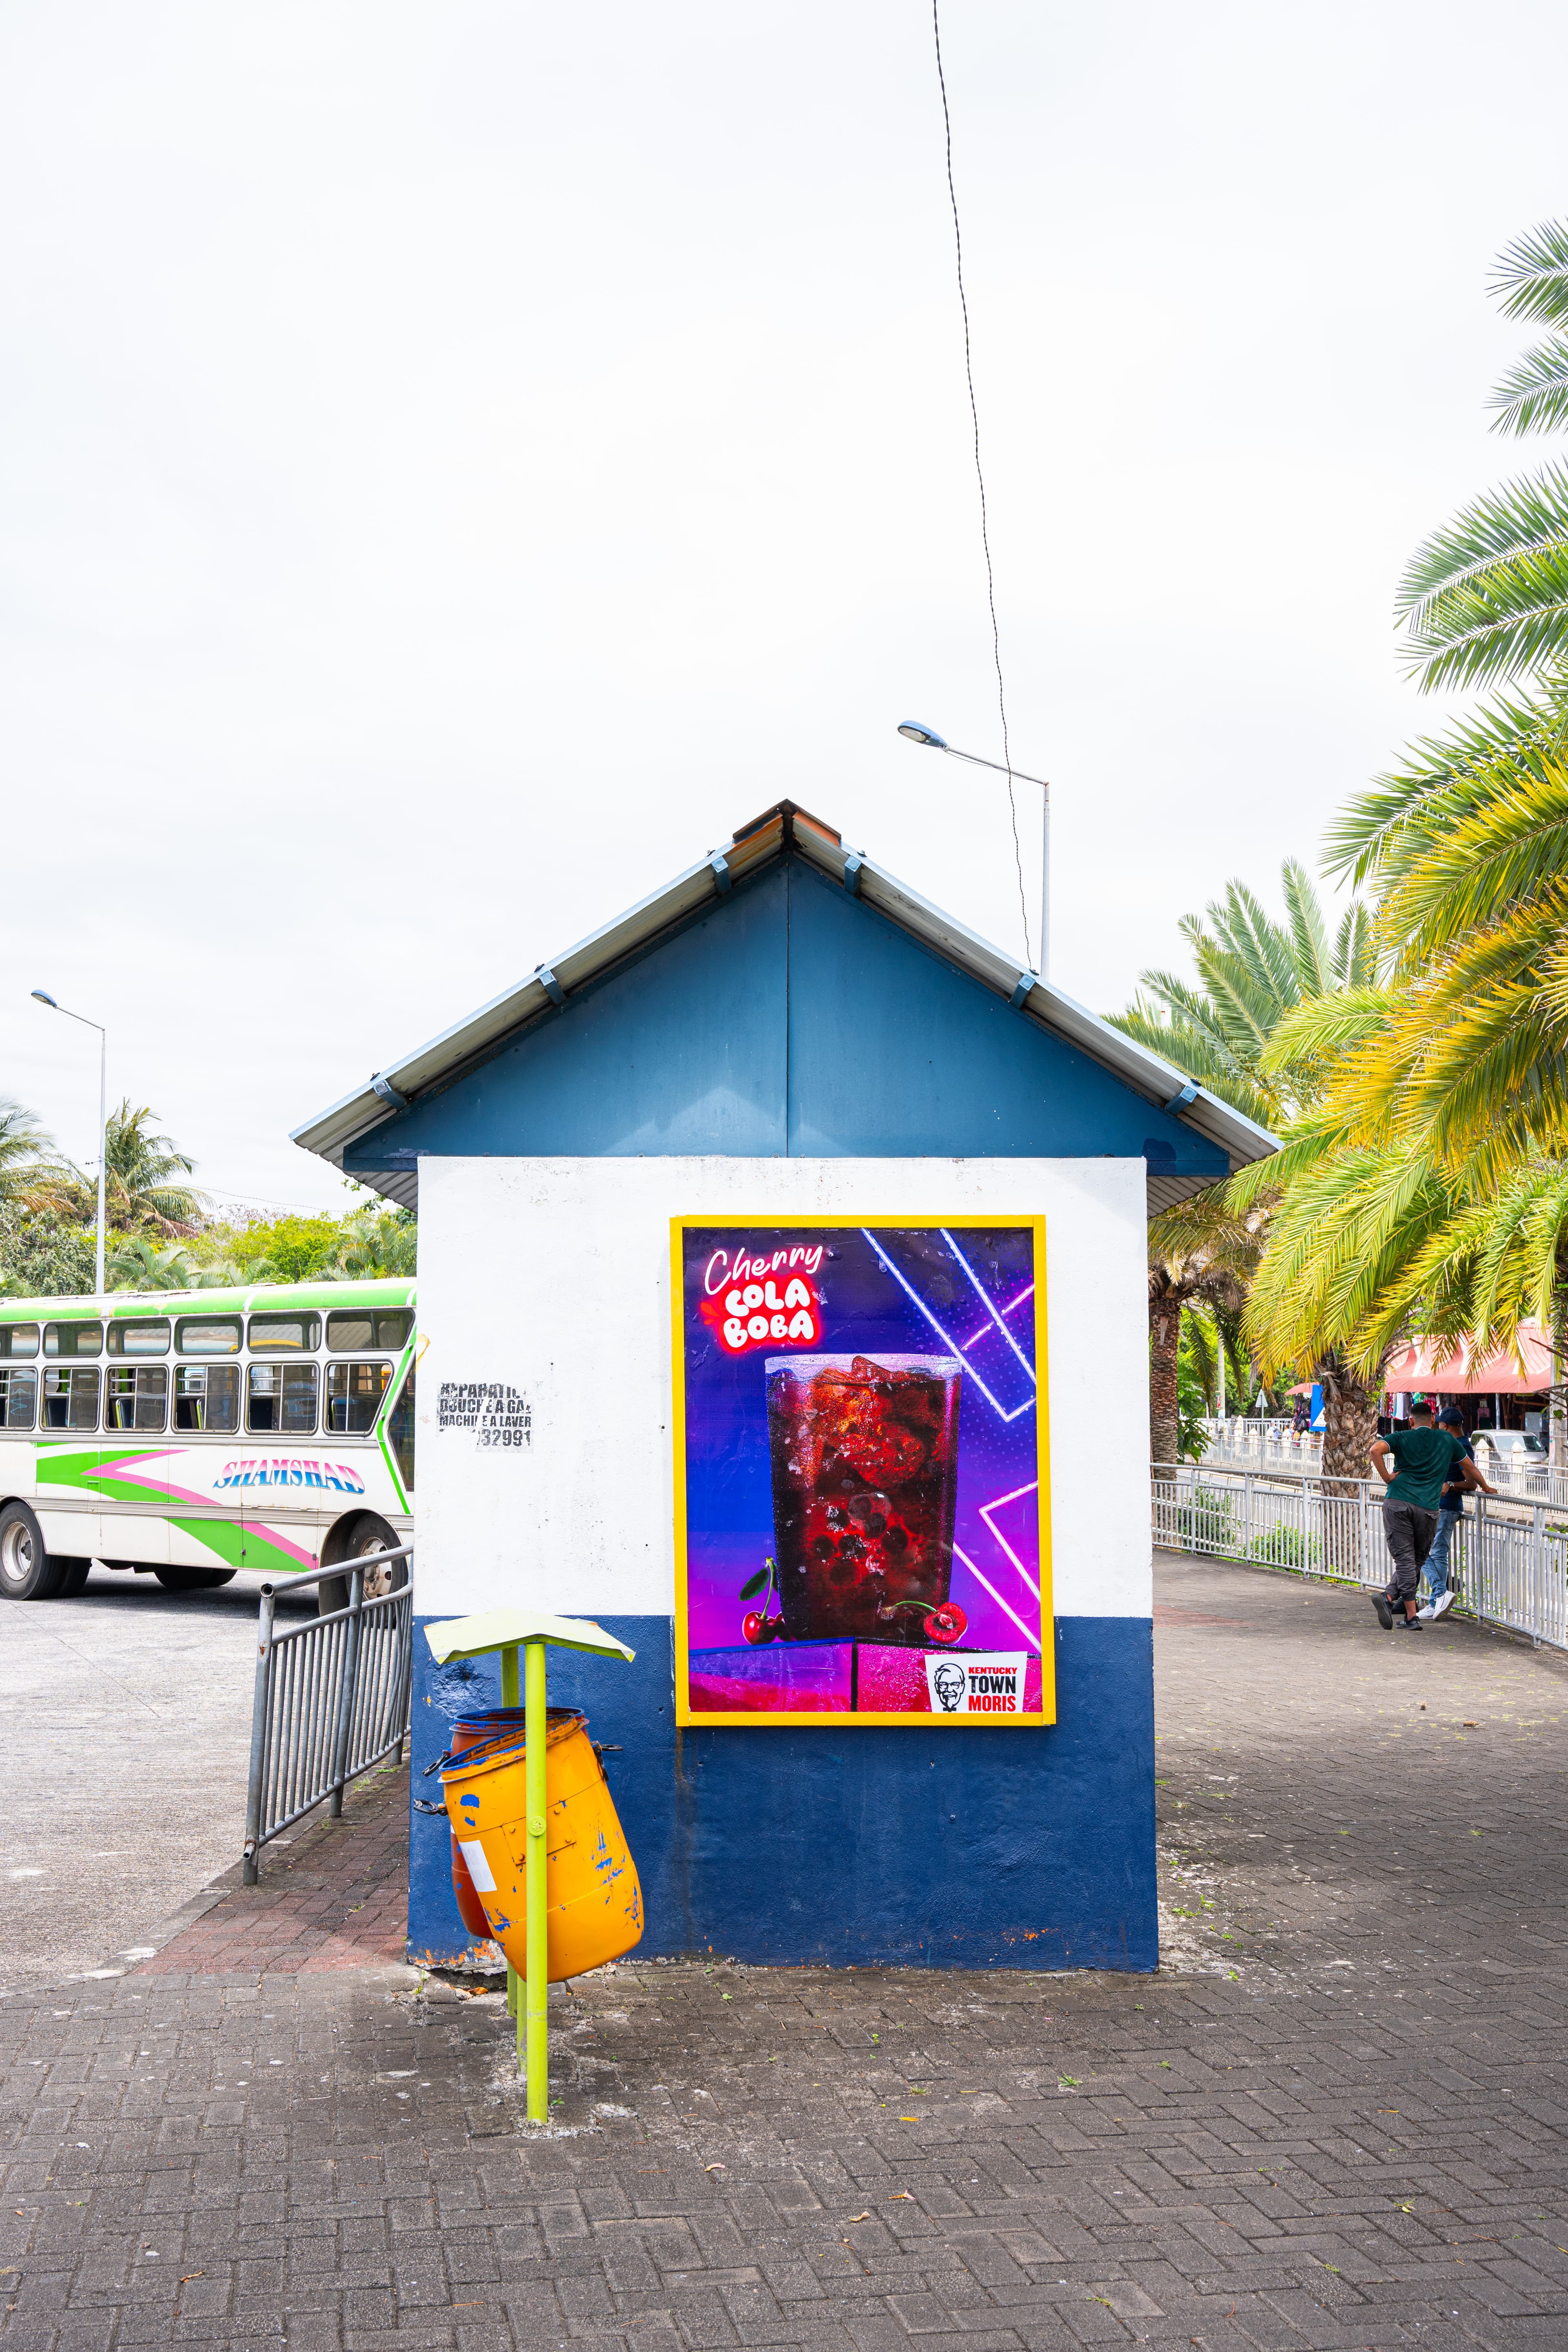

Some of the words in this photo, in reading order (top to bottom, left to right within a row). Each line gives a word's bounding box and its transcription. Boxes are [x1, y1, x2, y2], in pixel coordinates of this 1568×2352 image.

[705, 1245, 823, 1295] Cherry
[725, 1278, 810, 1316] COLA
[724, 1310, 814, 1348] BOBA
[495, 1400, 504, 1413] A
[490, 1415, 497, 1427] A
[499, 1416, 531, 1428] LAVER
[212, 1459, 365, 1495] SHAMSHAD
[968, 1675, 1016, 1693] TOWN
[968, 1695, 1016, 1712] MORIS
